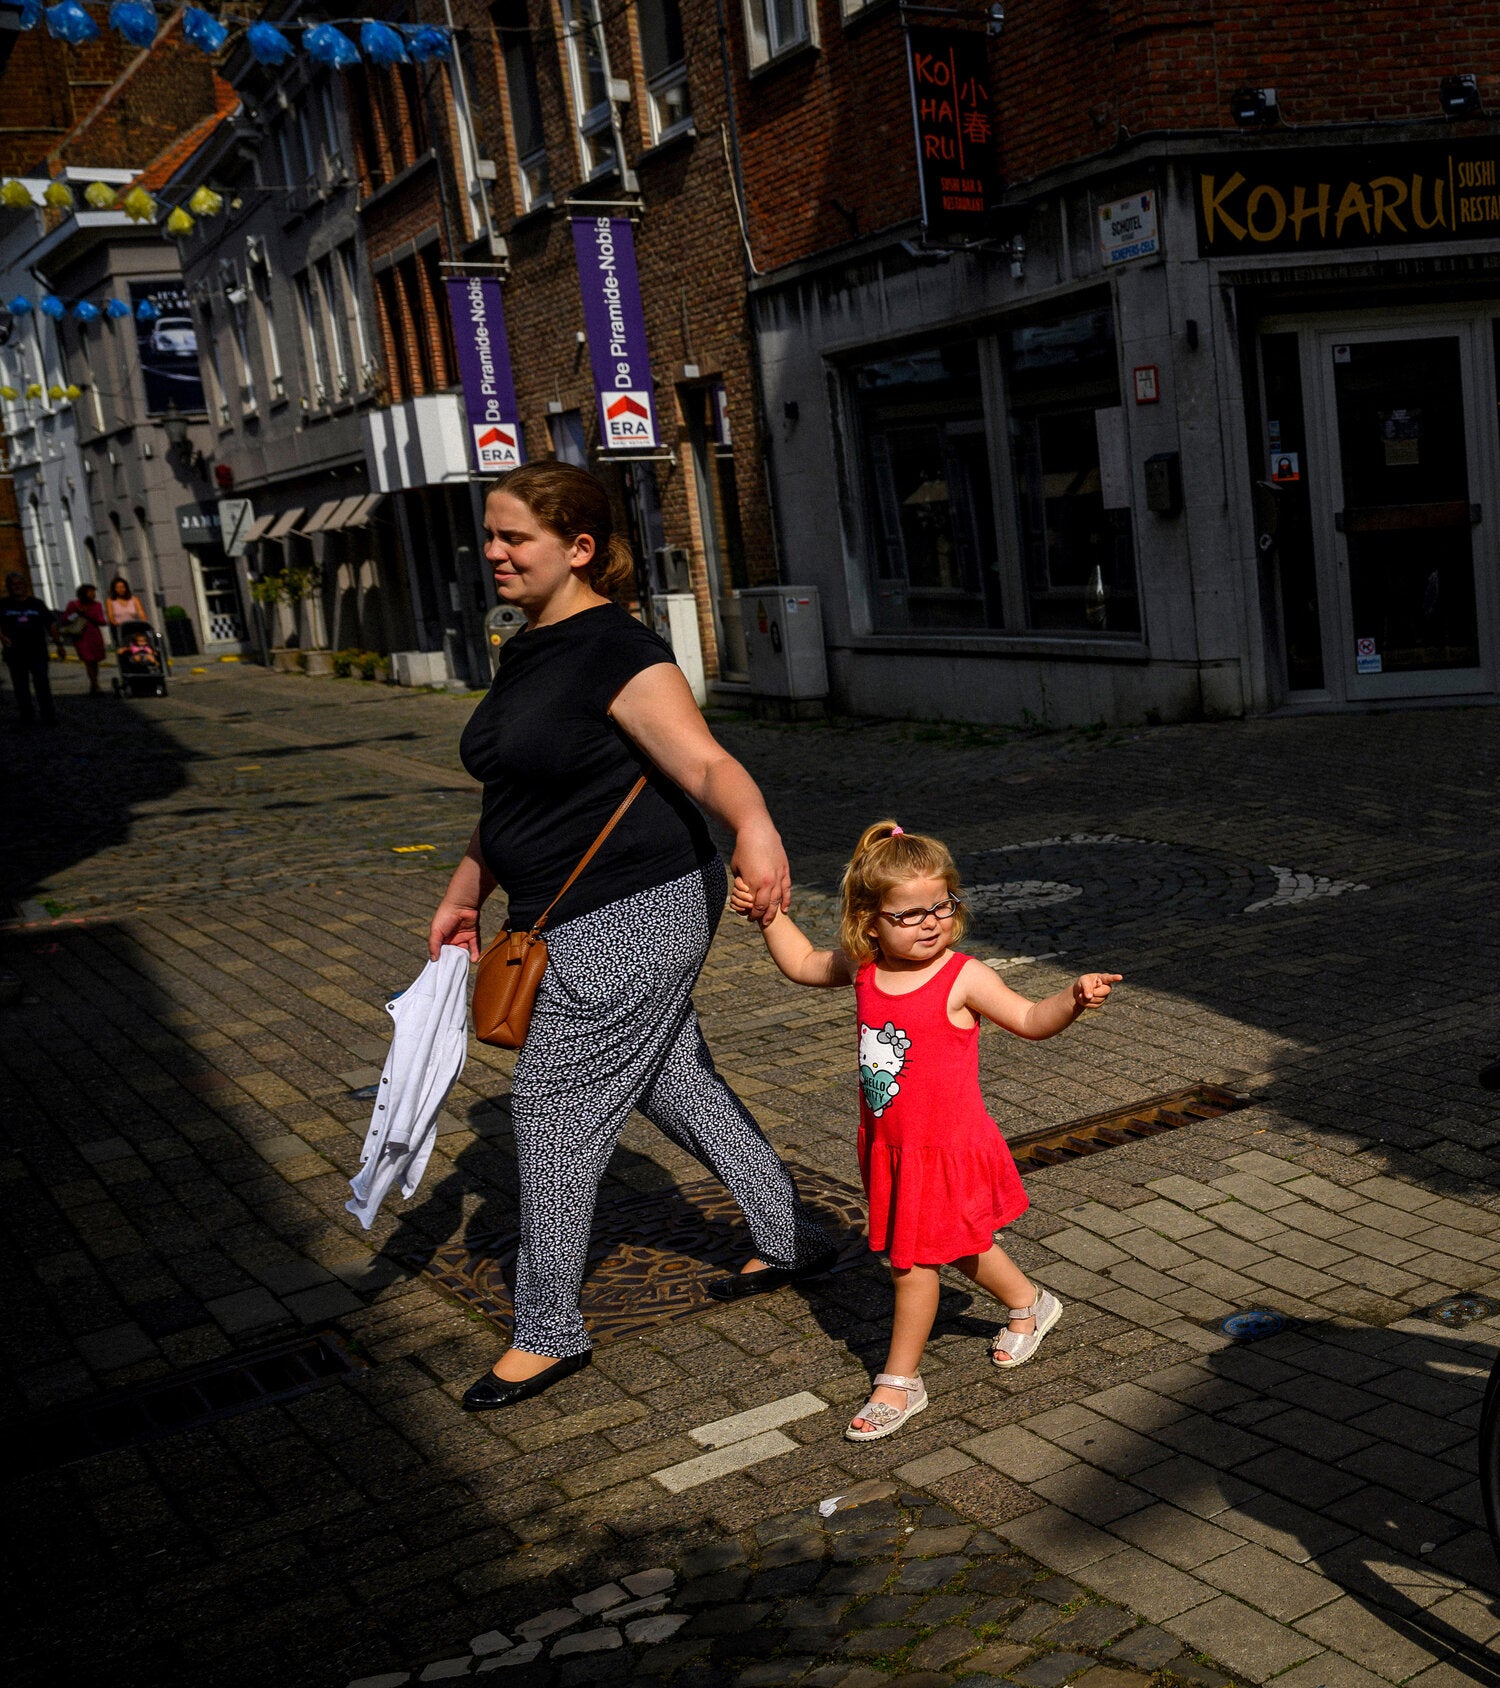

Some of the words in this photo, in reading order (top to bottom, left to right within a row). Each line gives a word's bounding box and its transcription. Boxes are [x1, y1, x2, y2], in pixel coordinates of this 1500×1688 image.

[914, 51, 950, 86] KO
[920, 97, 954, 124] HA
[960, 75, 993, 145] 小春
[923, 133, 956, 160] RU
[1458, 158, 1496, 189] SUSHI
[1200, 170, 1448, 244] KOHARU
[595, 216, 628, 358] Piramide-Nobis
[466, 277, 498, 396] Piramide-Nobis
[615, 362, 633, 388] De
[485, 399, 499, 422] De
[611, 421, 648, 435] ERA
[482, 449, 515, 462] ERA
[864, 1076, 886, 1092] HELLO
